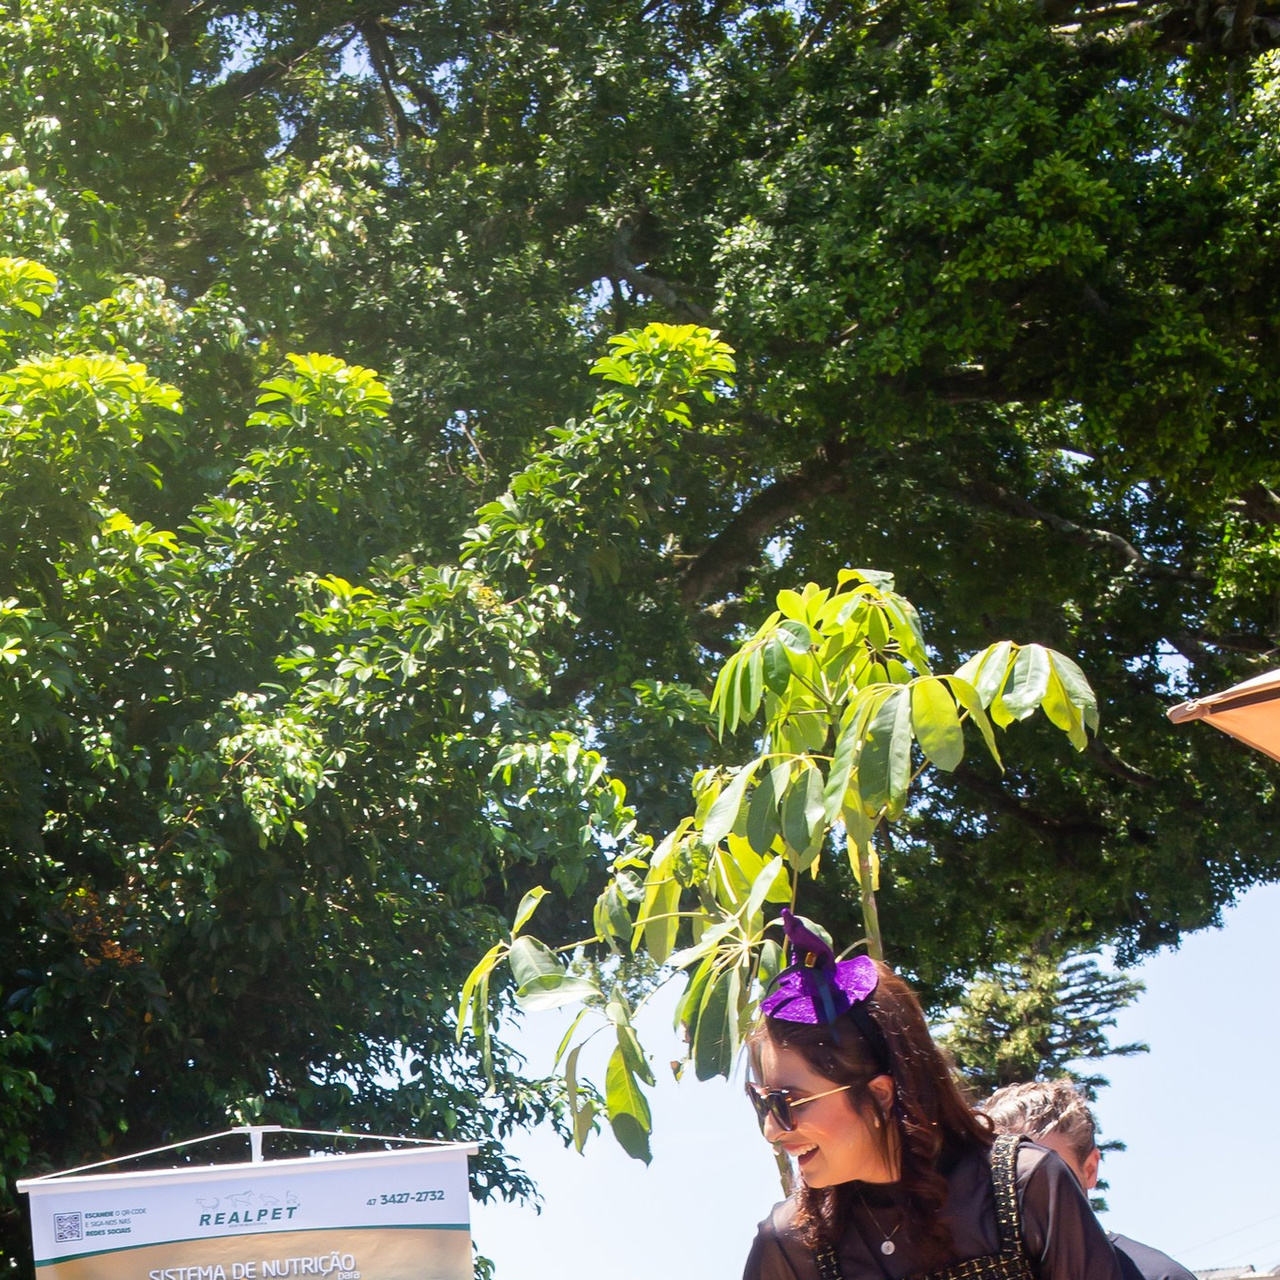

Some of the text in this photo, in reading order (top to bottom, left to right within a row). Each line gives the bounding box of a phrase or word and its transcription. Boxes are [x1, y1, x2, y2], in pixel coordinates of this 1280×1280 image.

[366, 1190, 445, 1206] 47 3427-2732
[199, 1206, 297, 1227] REALPET
[85, 1227, 132, 1237] REDES SOCIAIS
[232, 1261, 256, 1280] DE
[262, 1251, 356, 1279] NUTRIÇÃO
